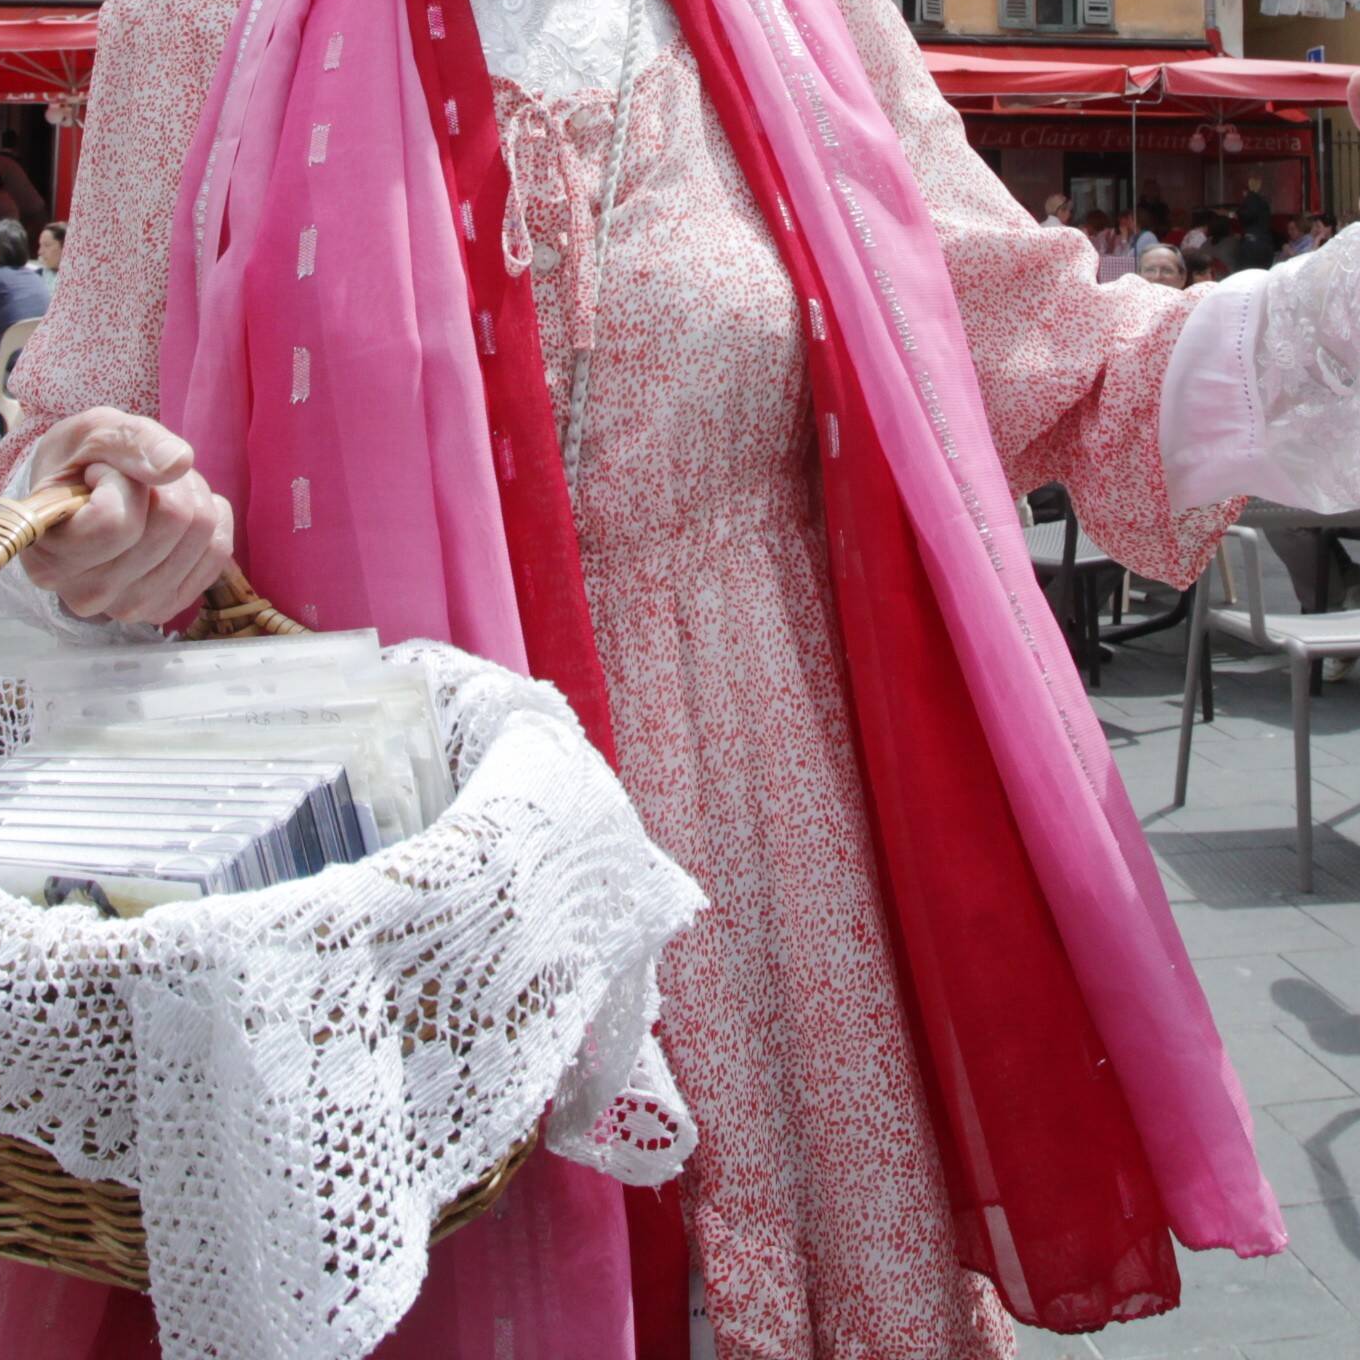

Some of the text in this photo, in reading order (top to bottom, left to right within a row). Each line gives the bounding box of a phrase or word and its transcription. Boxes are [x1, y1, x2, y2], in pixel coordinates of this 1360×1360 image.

[979, 124, 1192, 149] La Claire Fontain
